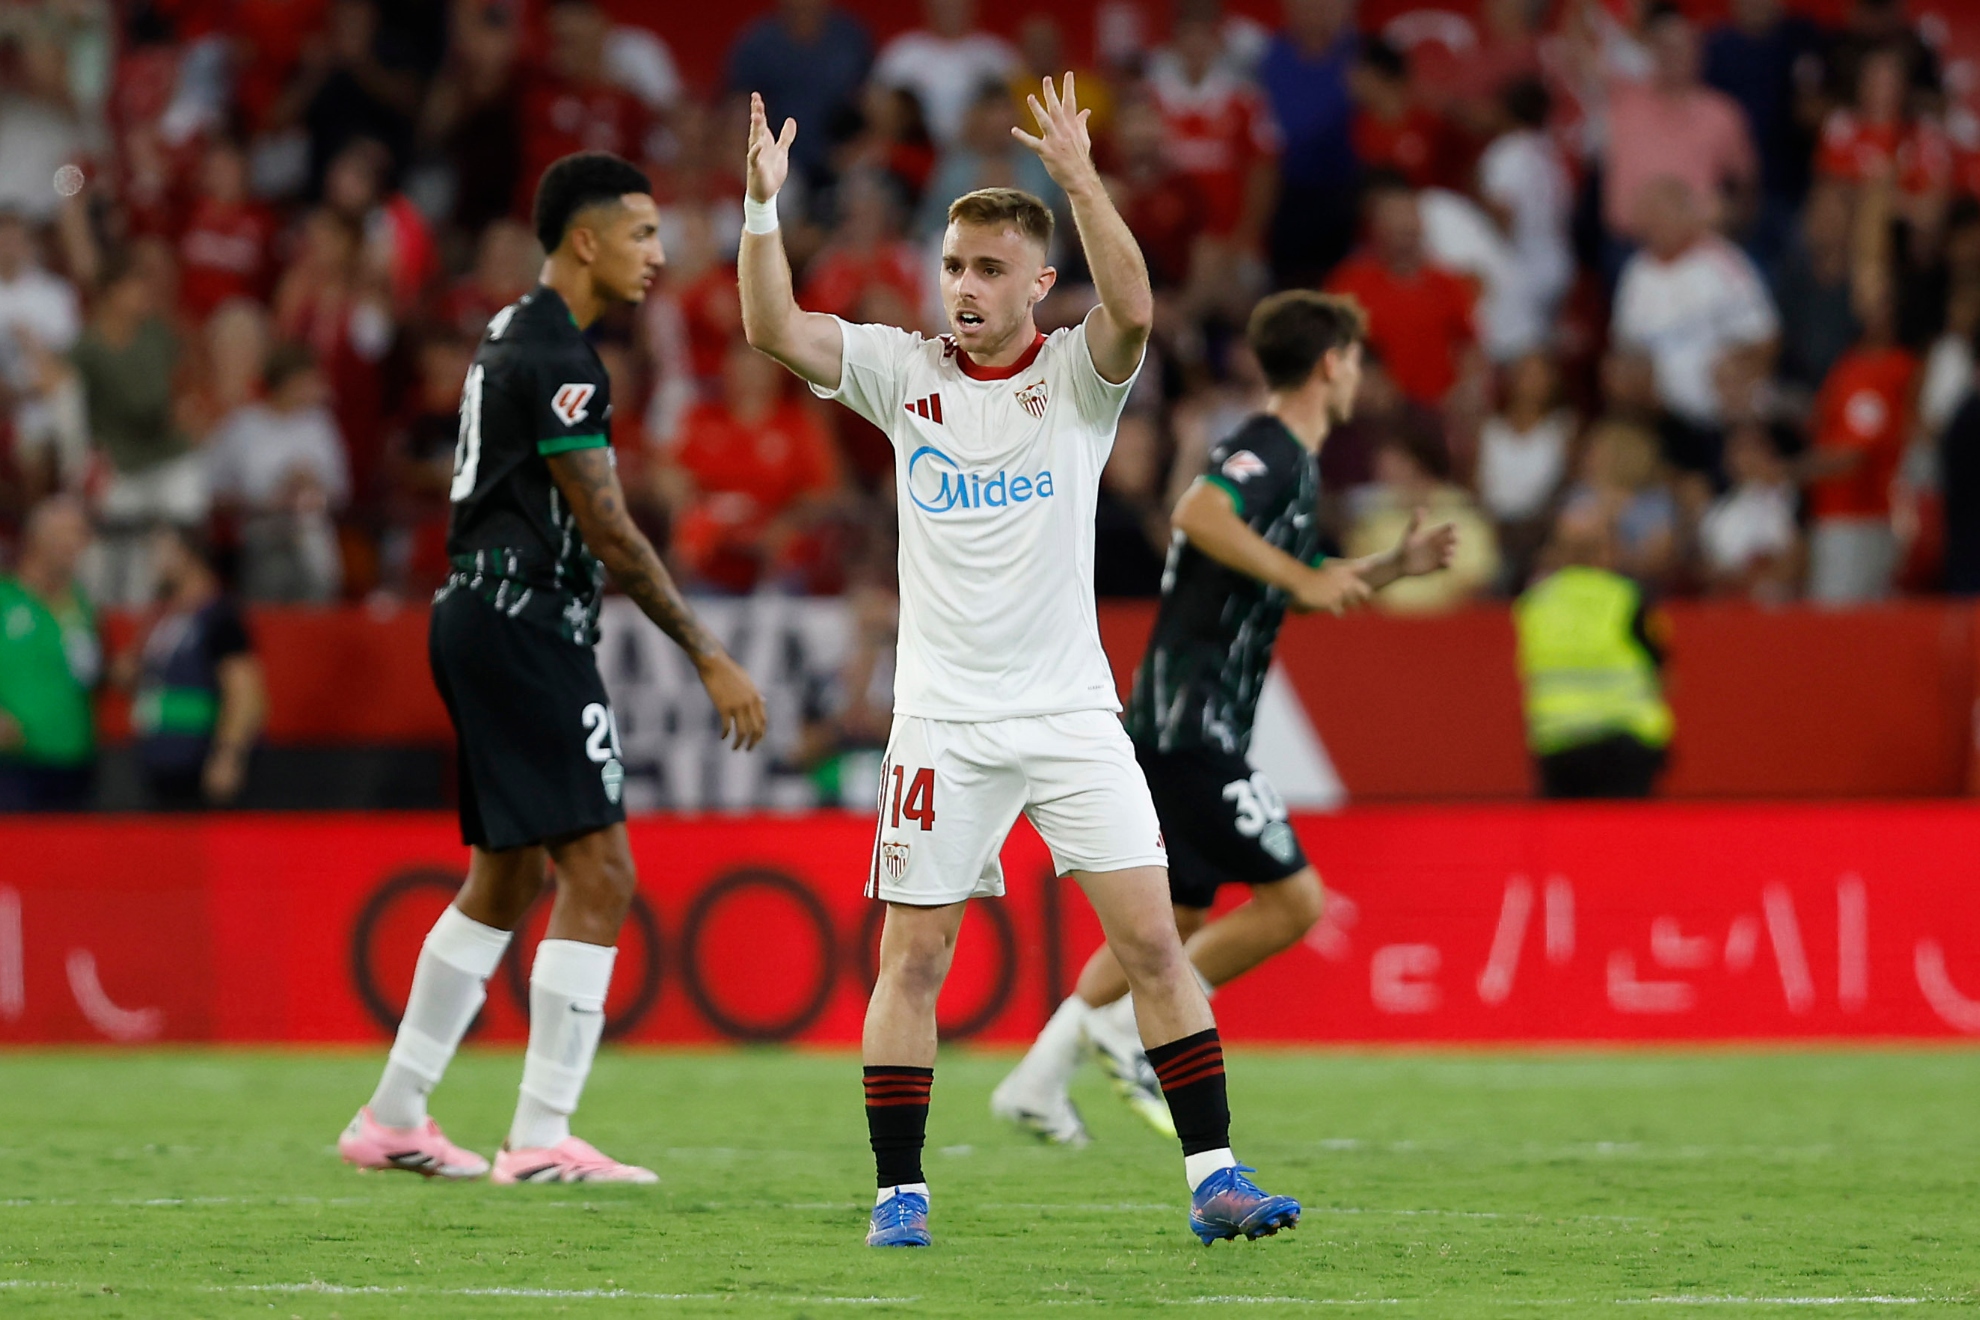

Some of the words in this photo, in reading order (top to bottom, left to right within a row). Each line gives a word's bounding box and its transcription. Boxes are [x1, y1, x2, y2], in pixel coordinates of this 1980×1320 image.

[909, 452, 1054, 512] Midea
[891, 764, 936, 832] 14
[1221, 770, 1288, 838] 30
